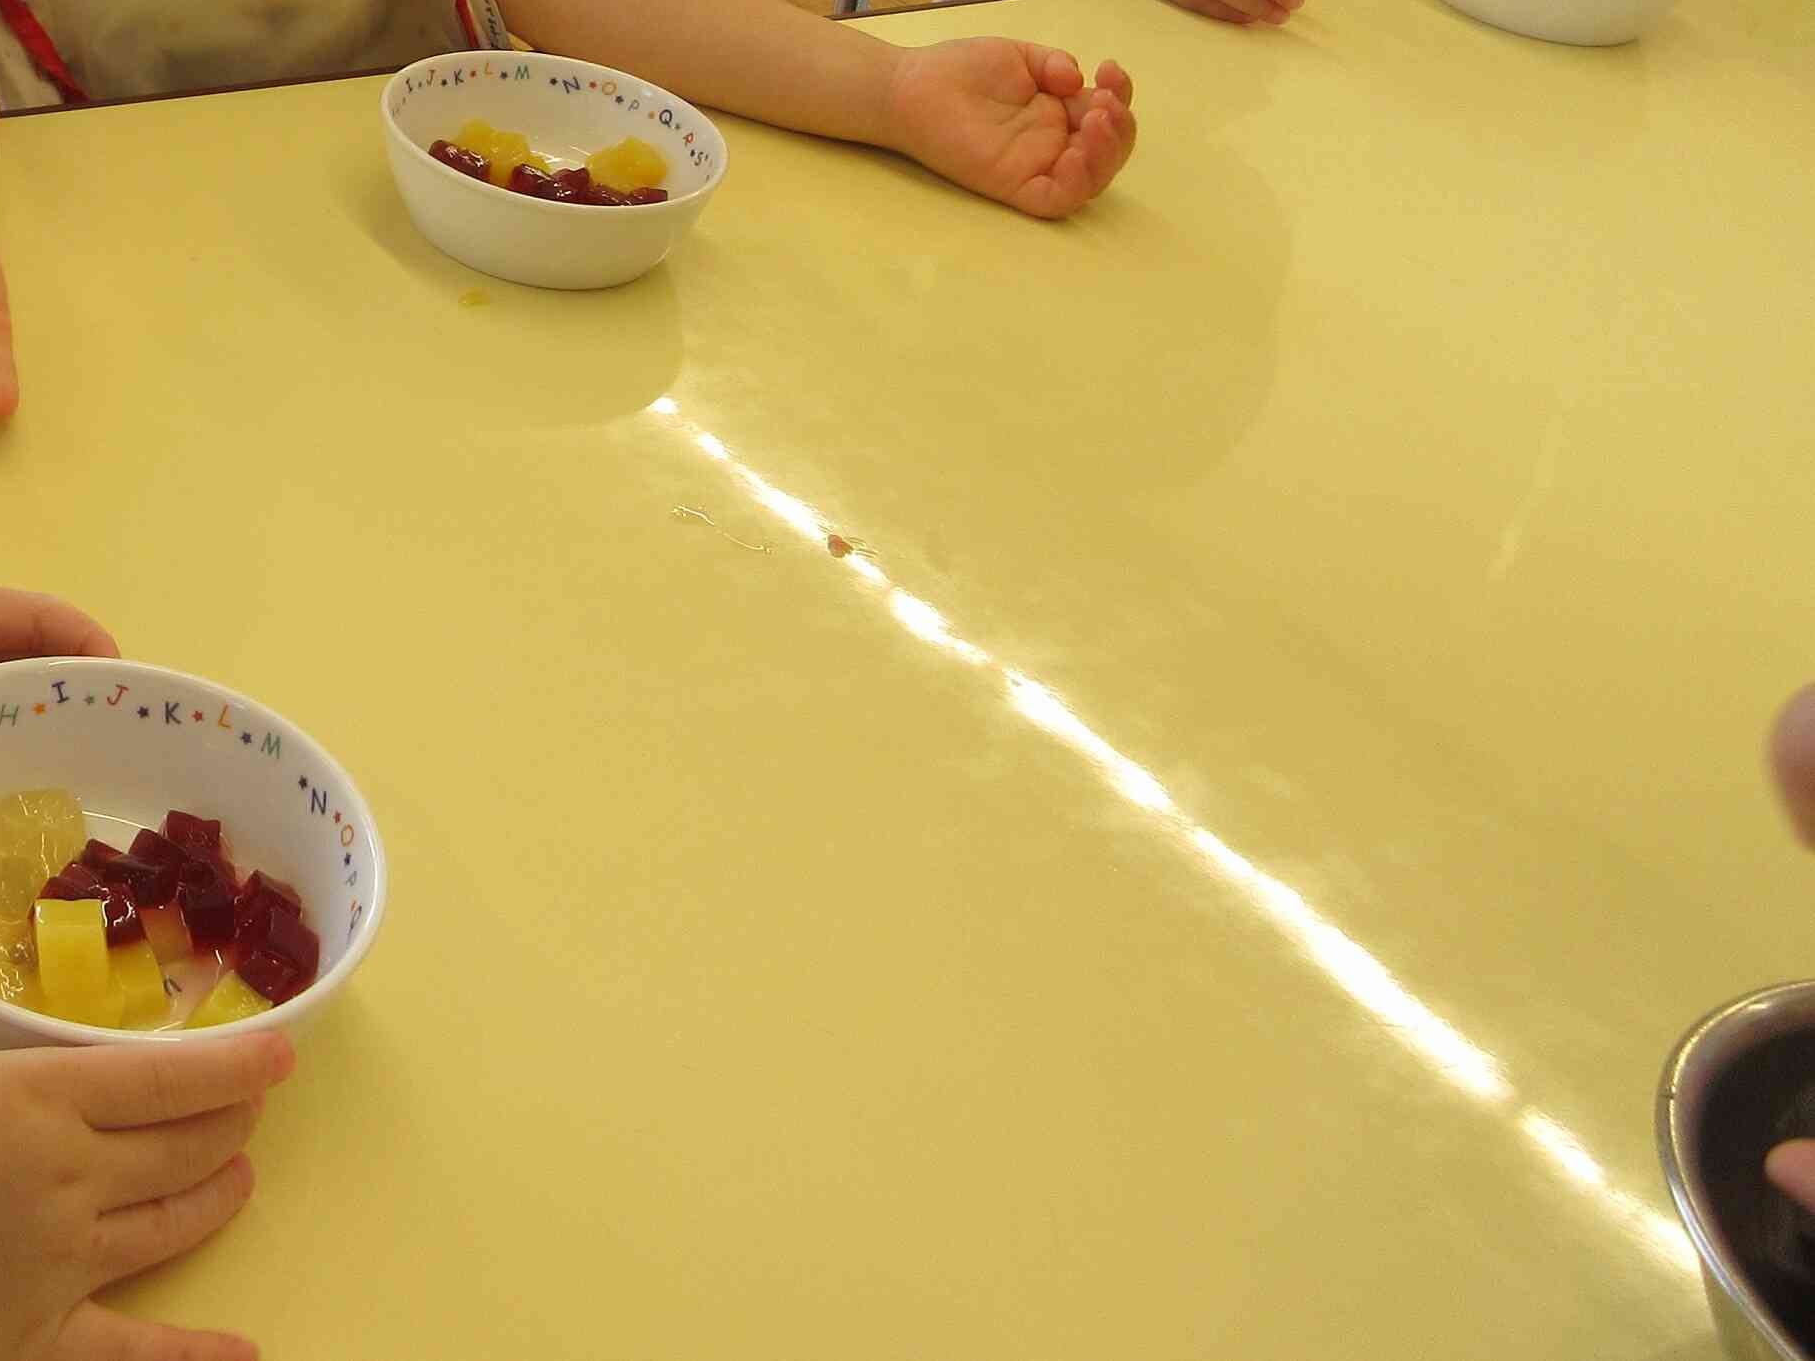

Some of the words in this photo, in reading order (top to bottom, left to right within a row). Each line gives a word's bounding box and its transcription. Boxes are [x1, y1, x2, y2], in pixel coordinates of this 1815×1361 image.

[453, 68, 465, 87] K
[514, 64, 530, 81] M
[561, 76, 581, 95] N
[658, 108, 673, 128] Q
[51, 680, 70, 704] I
[106, 684, 130, 707] J
[164, 700, 182, 725] K
[217, 704, 233, 730] L
[260, 732, 282, 760] M
[310, 787, 327, 816] N
[340, 823, 355, 848] O
